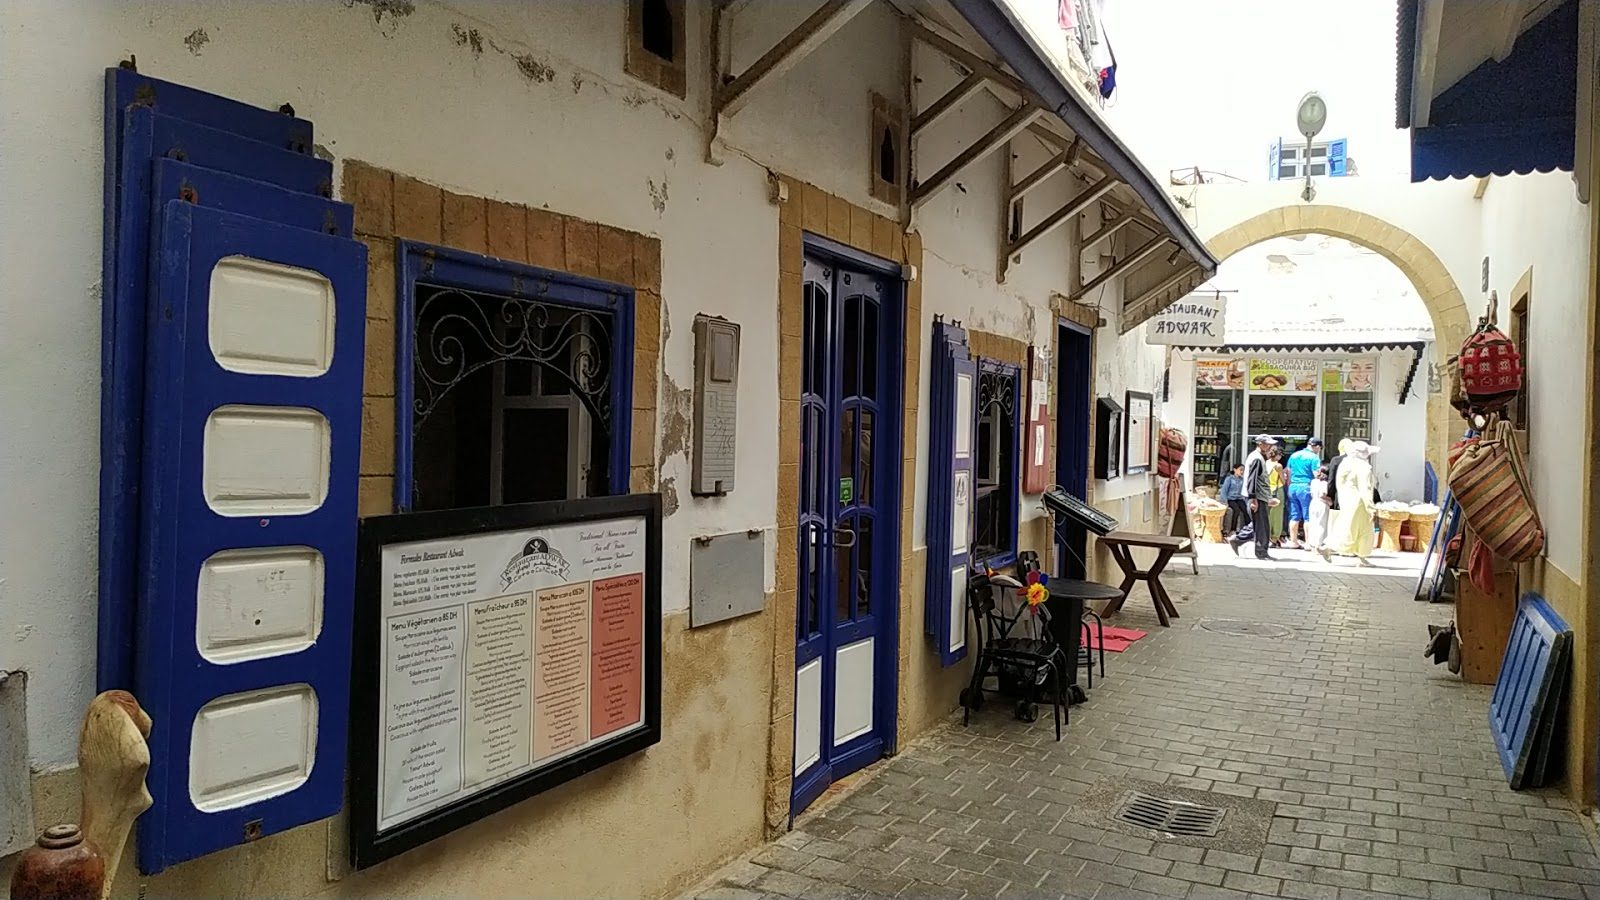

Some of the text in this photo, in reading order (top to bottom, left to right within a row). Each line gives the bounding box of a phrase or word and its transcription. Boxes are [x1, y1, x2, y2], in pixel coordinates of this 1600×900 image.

[1154, 304, 1219, 319] STAURANT
[1156, 320, 1216, 337] ADWAK
[422, 552, 448, 561] Restaurant
[391, 623, 406, 631] Menu
[450, 612, 457, 620] DH
